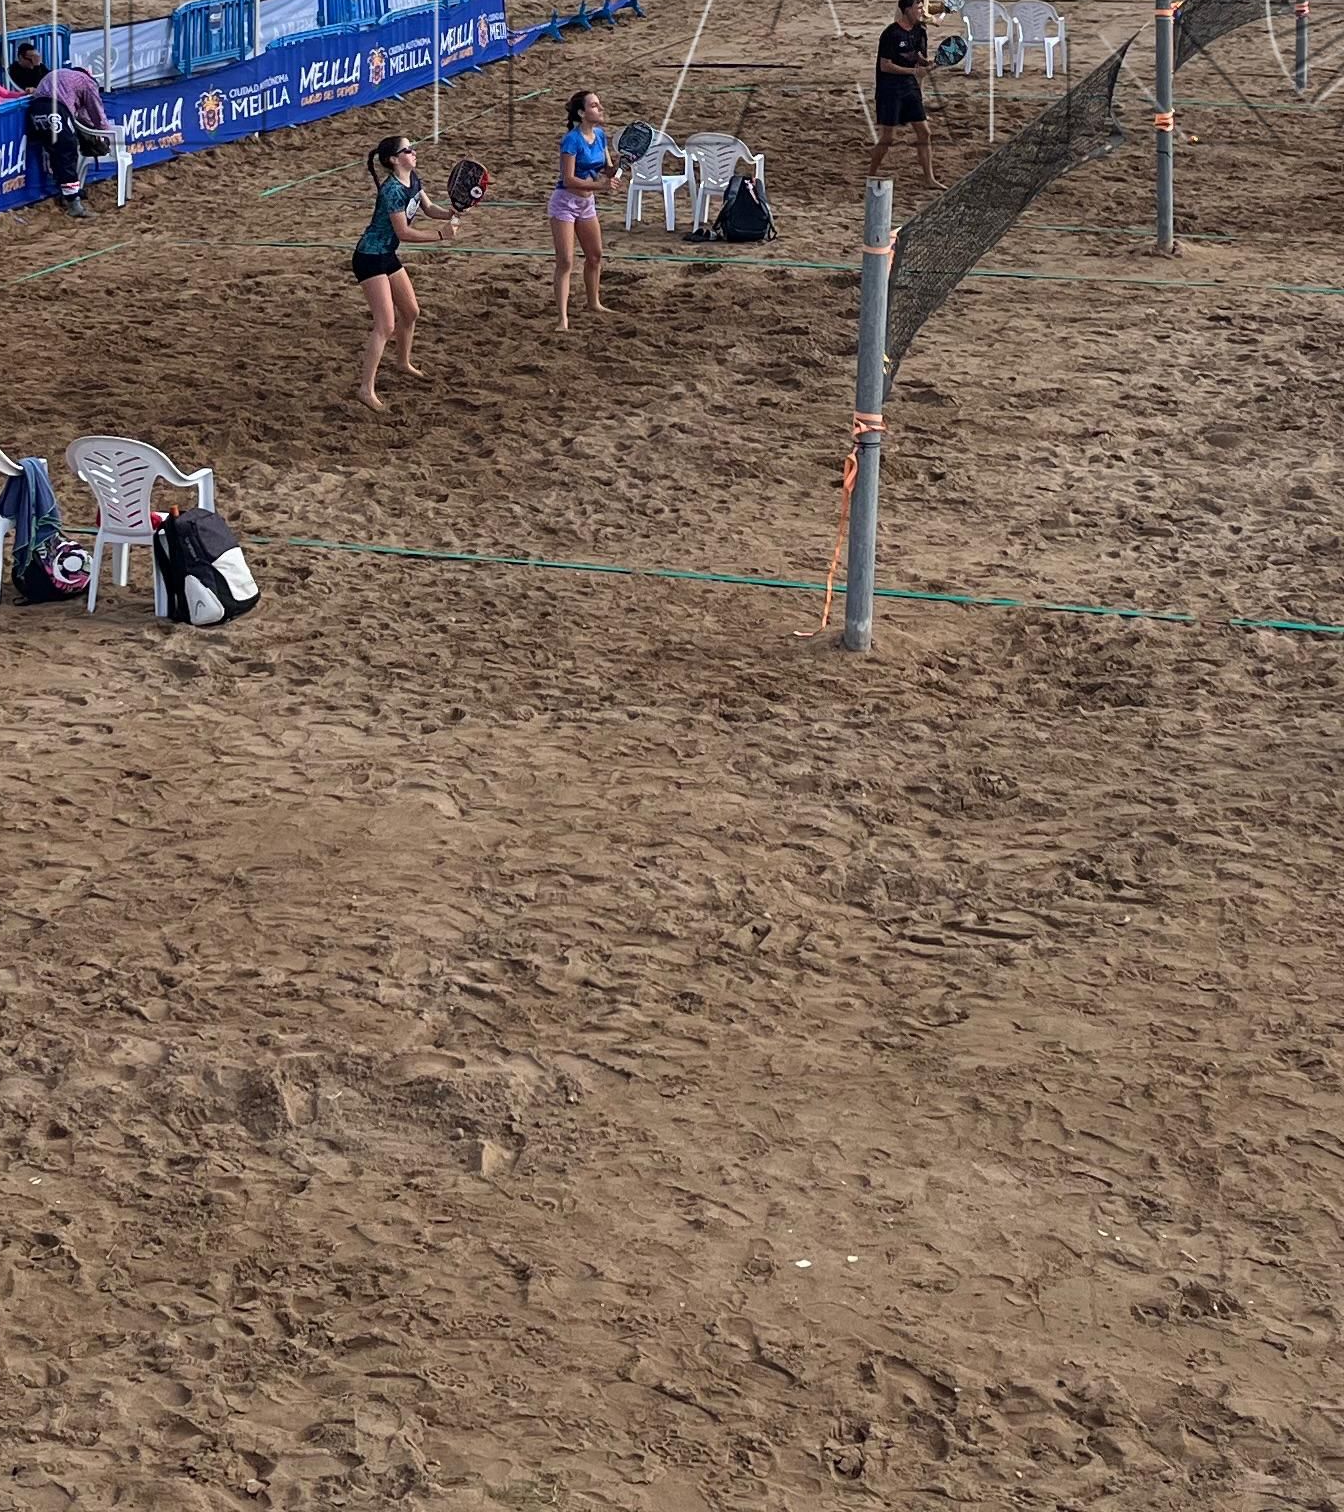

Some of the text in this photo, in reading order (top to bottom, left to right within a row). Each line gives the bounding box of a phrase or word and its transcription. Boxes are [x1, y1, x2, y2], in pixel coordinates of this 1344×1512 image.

[440, 18, 474, 56] MELILLA
[299, 53, 361, 94] MELILLA
[389, 50, 432, 76] MELILLA
[229, 83, 260, 98] CIUDAD
[231, 86, 291, 120] MELILLA
[123, 97, 183, 141] MELILLA
